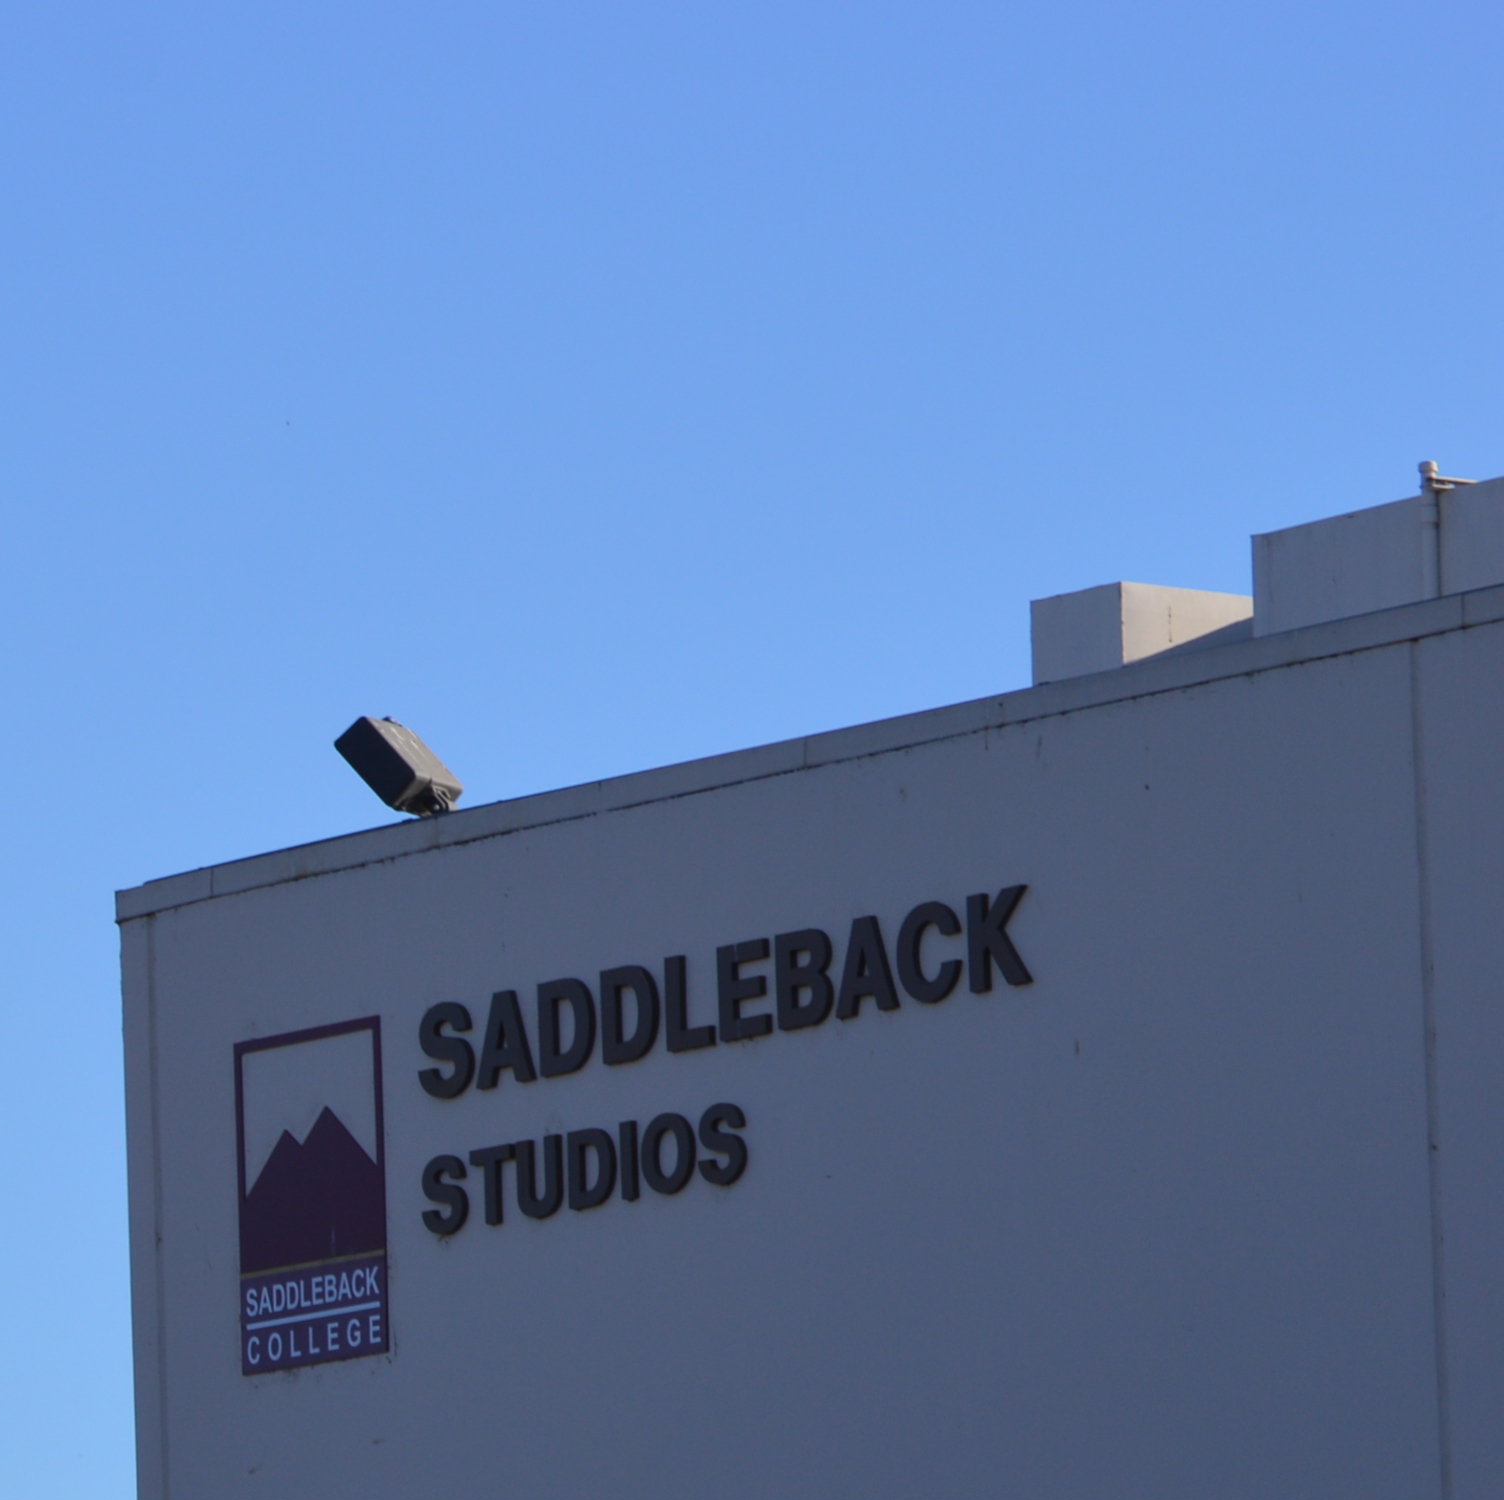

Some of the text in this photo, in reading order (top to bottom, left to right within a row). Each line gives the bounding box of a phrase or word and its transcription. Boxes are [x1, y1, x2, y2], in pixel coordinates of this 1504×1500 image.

[418, 883, 1034, 1099] SADDLEBACK
[421, 1102, 748, 1236] STUDIOS
[246, 1266, 380, 1317] SADDLEBACK
[247, 1315, 381, 1365] COLLEGE
